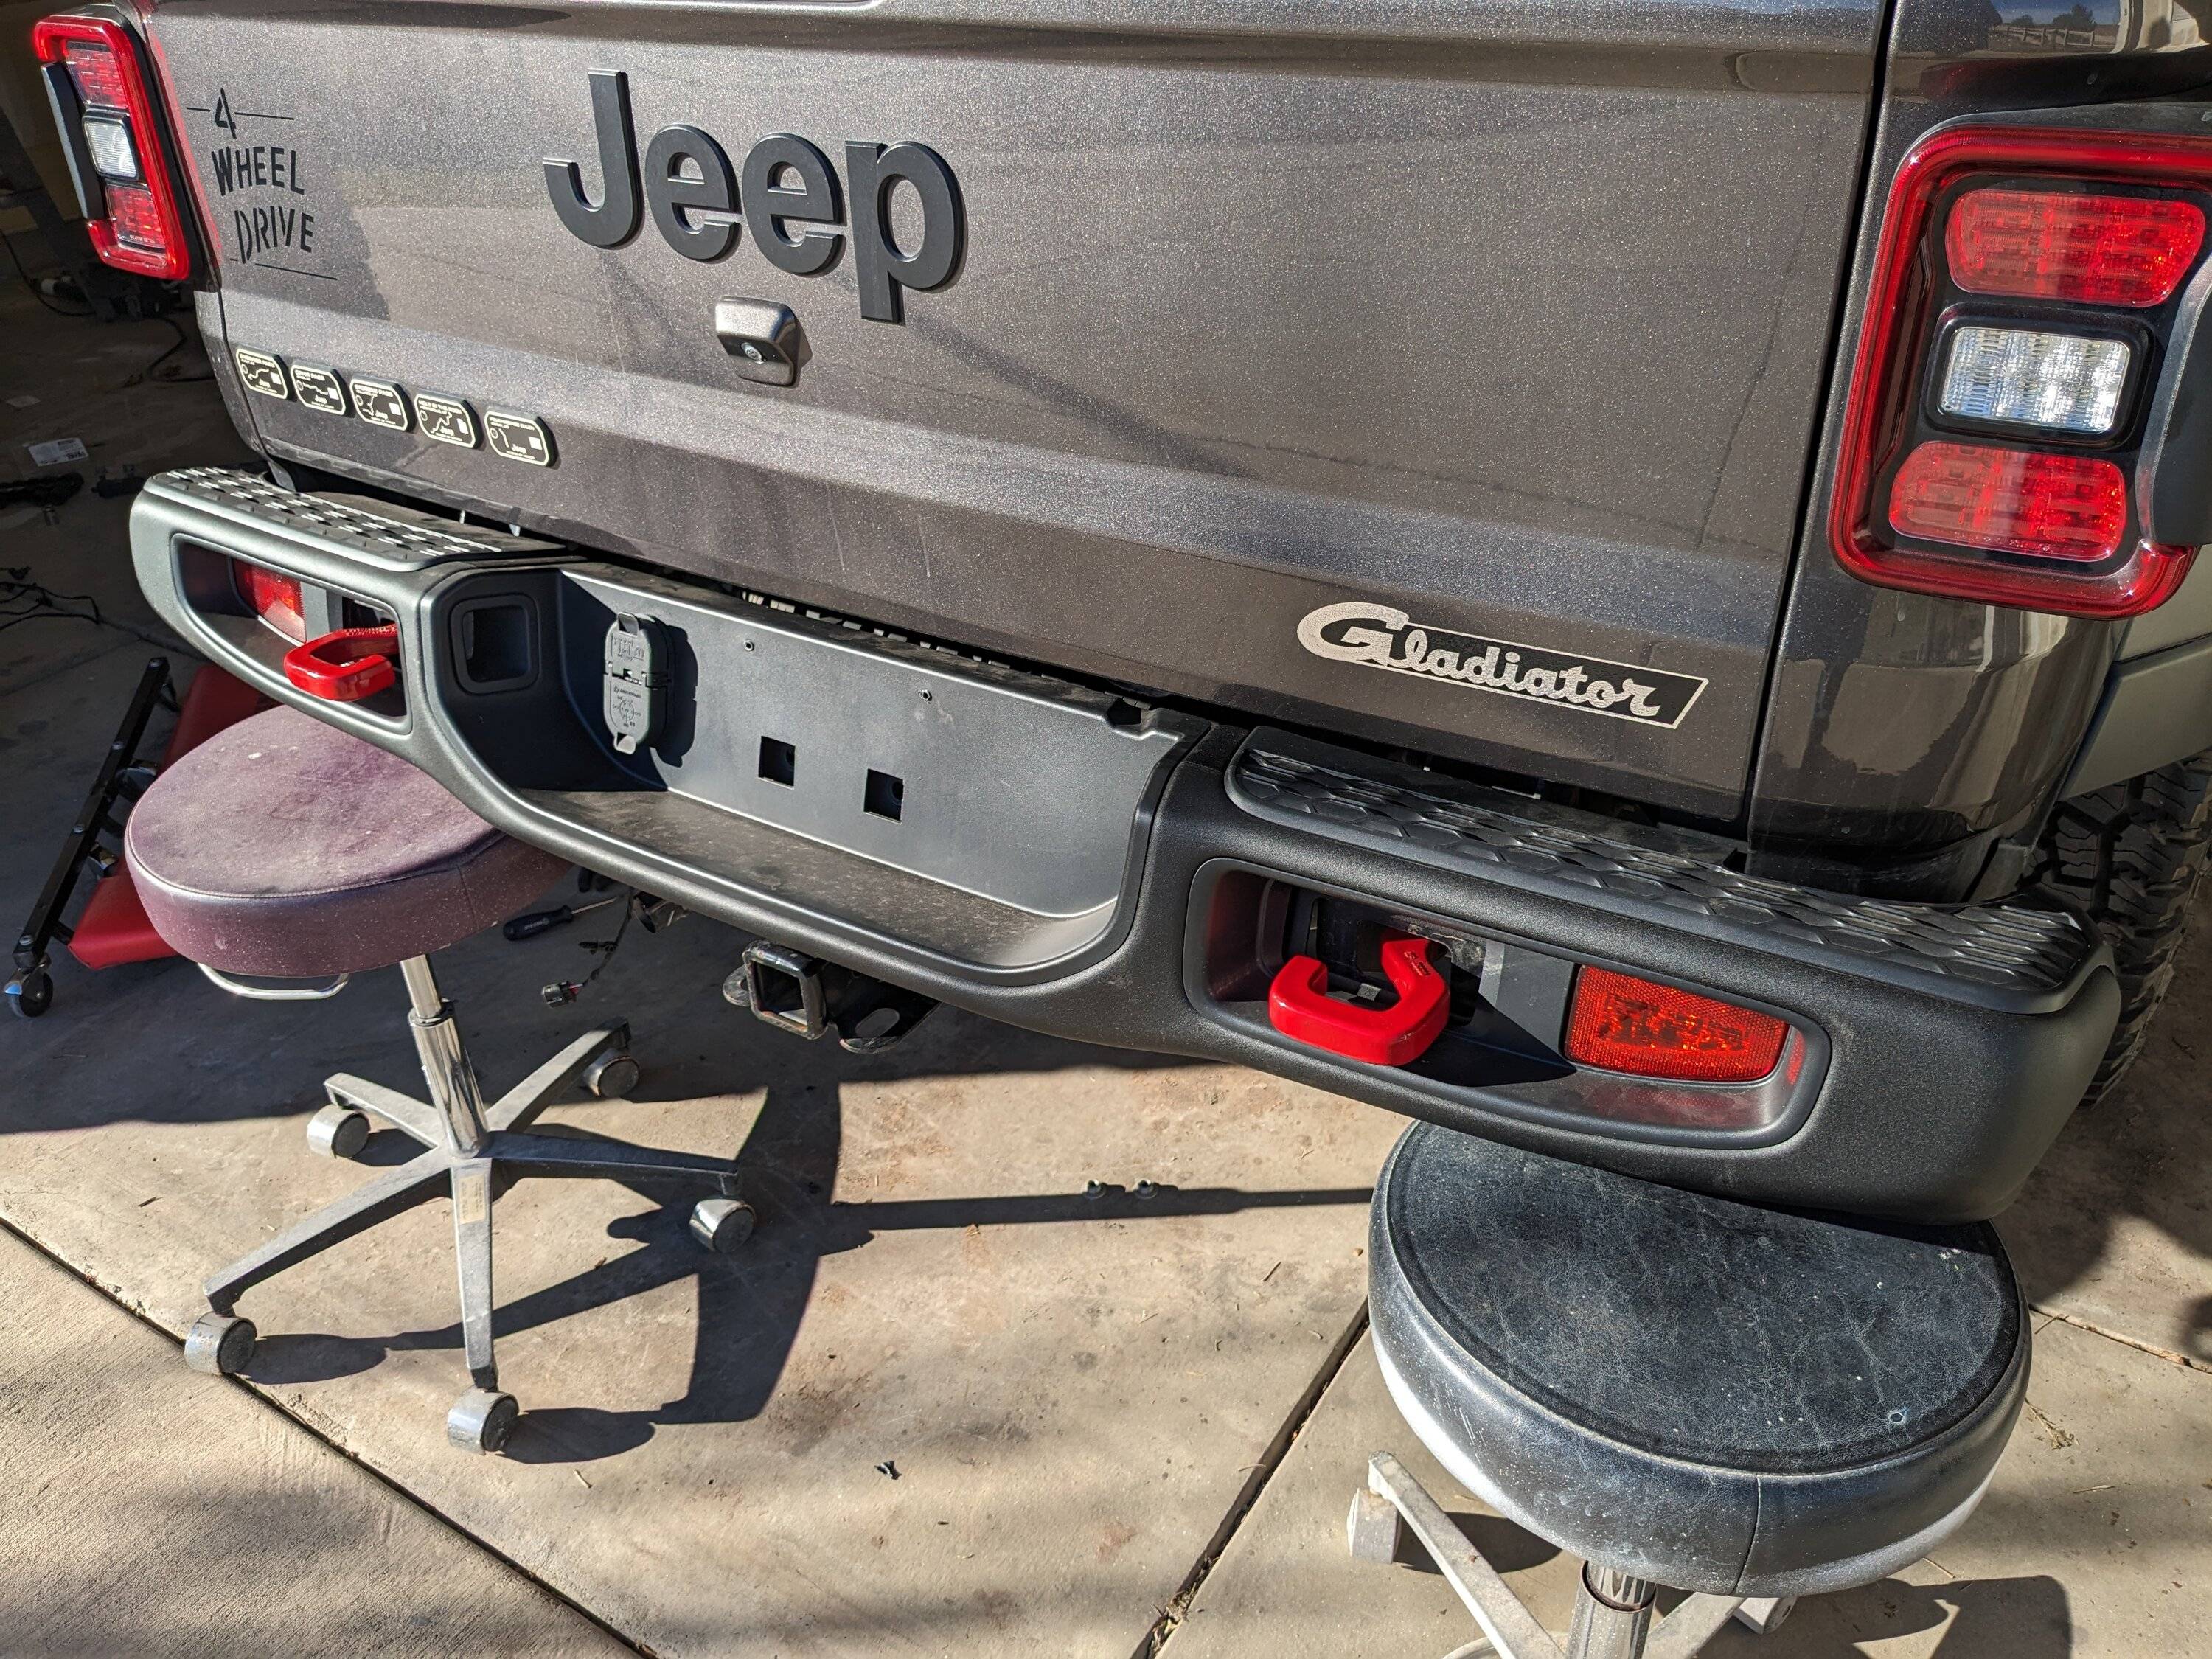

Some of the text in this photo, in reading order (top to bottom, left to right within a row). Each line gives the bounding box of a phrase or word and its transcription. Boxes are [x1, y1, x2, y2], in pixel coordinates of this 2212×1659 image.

[214, 87, 237, 139] 4
[211, 146, 305, 197] WHEEL
[542, 67, 967, 324] Jeep
[234, 205, 315, 264] DRIVE
[1296, 601, 1663, 717] Gladiator
